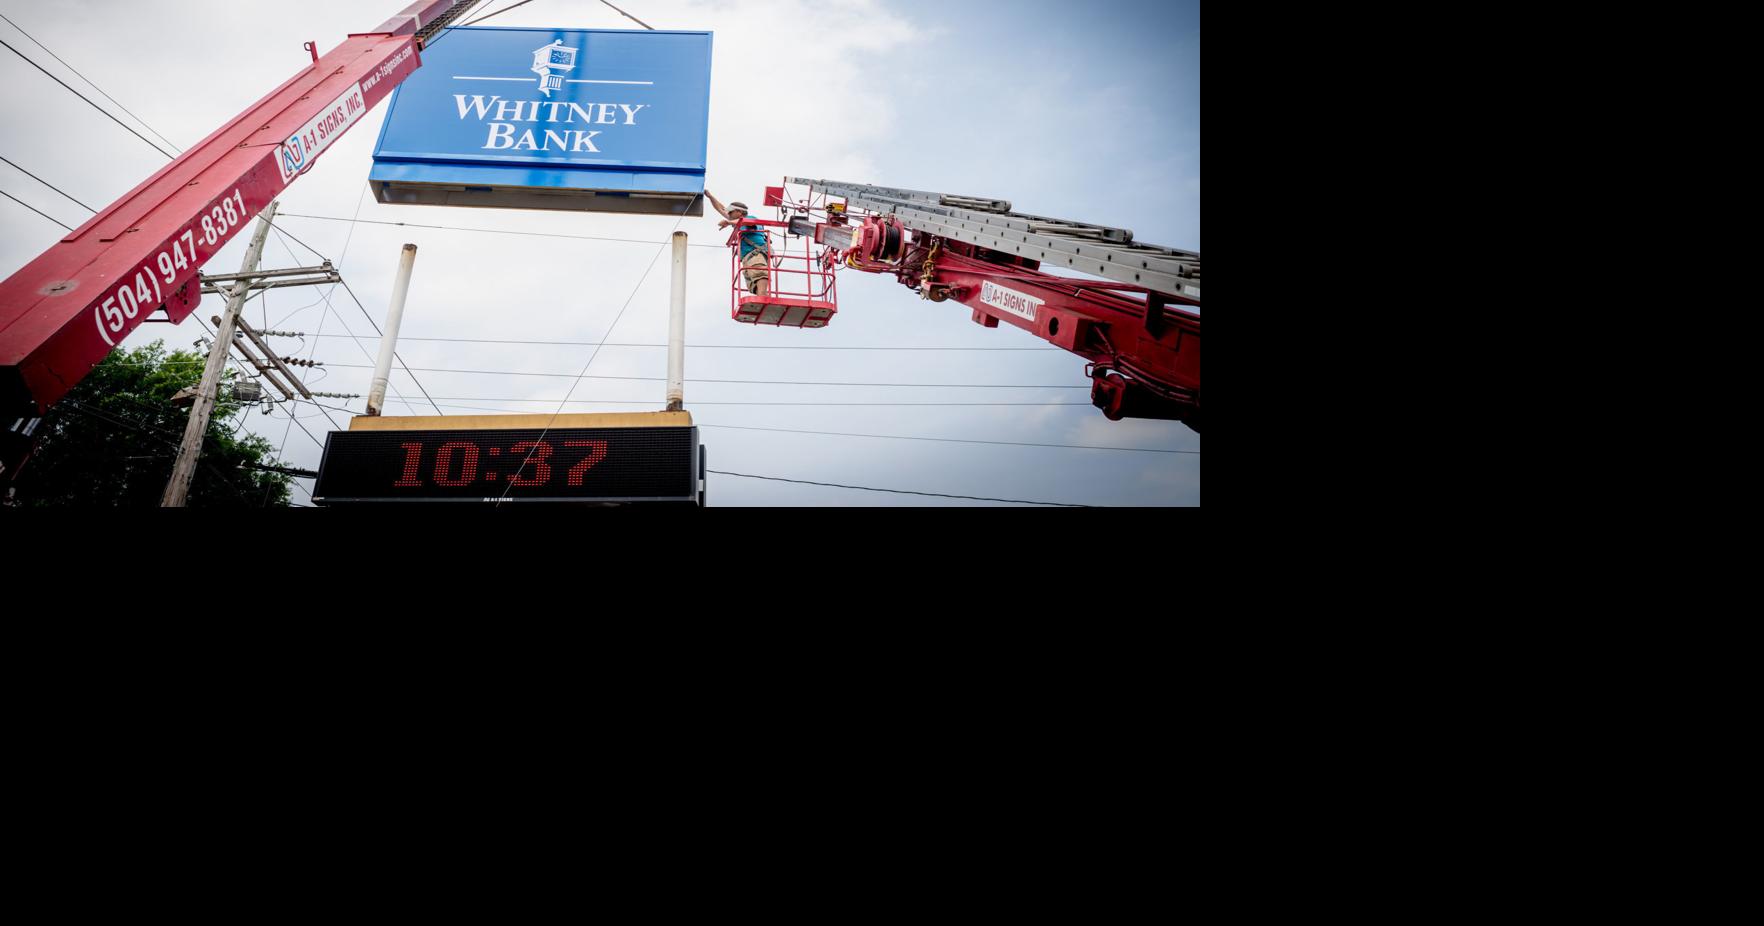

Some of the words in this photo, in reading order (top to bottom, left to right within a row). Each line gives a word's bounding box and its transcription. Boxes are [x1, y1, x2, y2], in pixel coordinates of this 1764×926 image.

[362, 45, 413, 92] www.a-1signsinc.com
[303, 129, 317, 154] A-1
[346, 92, 363, 116] INC.
[453, 94, 644, 125] WHITNEY
[481, 122, 602, 152] BANK
[94, 265, 162, 346] (504)
[157, 188, 247, 285] 947-8381
[992, 289, 1004, 305] A-1
[1003, 292, 1026, 313] SIGNS
[1026, 301, 1037, 317] IN
[394, 440, 608, 488] 10:37
